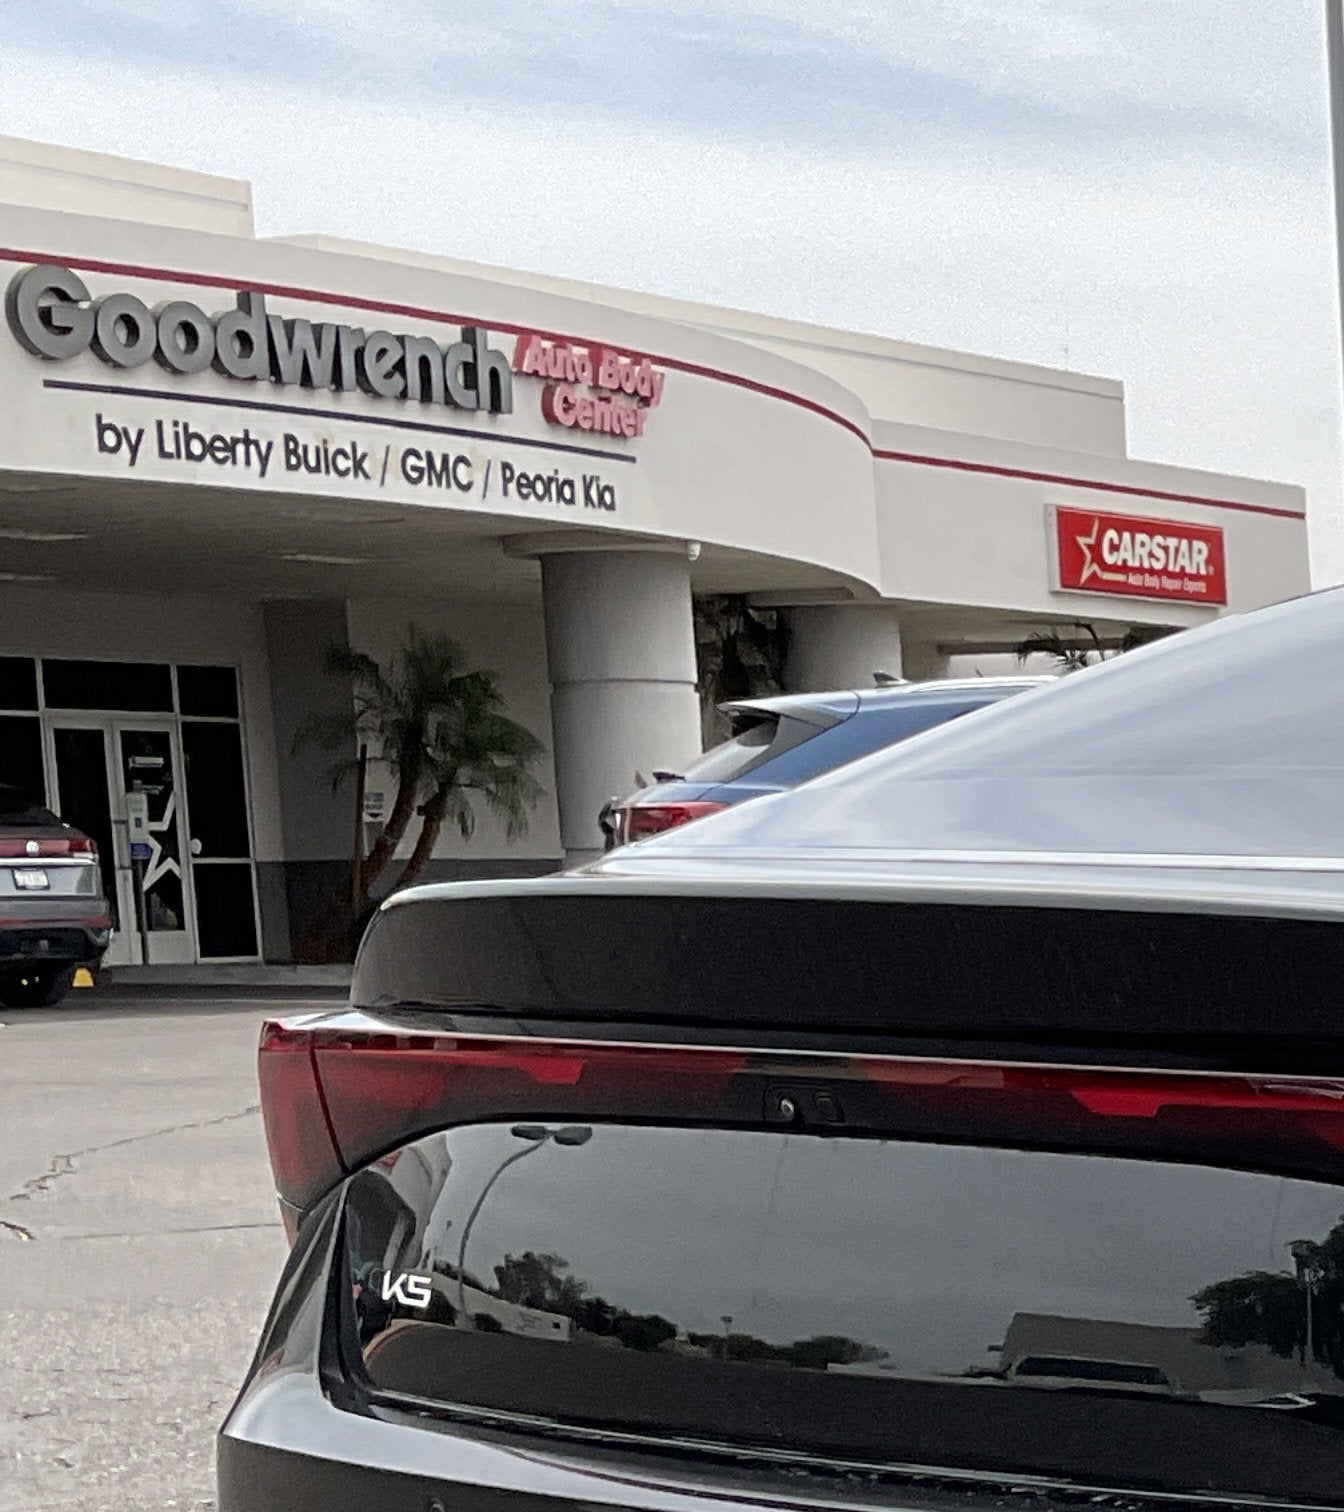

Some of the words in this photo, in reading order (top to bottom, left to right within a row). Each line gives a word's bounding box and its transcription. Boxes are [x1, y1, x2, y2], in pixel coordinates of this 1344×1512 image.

[5, 264, 513, 414] Goodwrench
[513, 335, 593, 386] Auto
[593, 349, 664, 407] Body
[542, 383, 644, 438] Center
[95, 413, 144, 467] by
[156, 420, 273, 478] Liberty
[283, 433, 371, 480] Buick
[401, 447, 474, 492] GMC
[500, 461, 576, 507] Peoria
[582, 474, 616, 512] Kia
[1102, 529, 1209, 576] CARSTAR
[381, 1270, 432, 1309] K5
